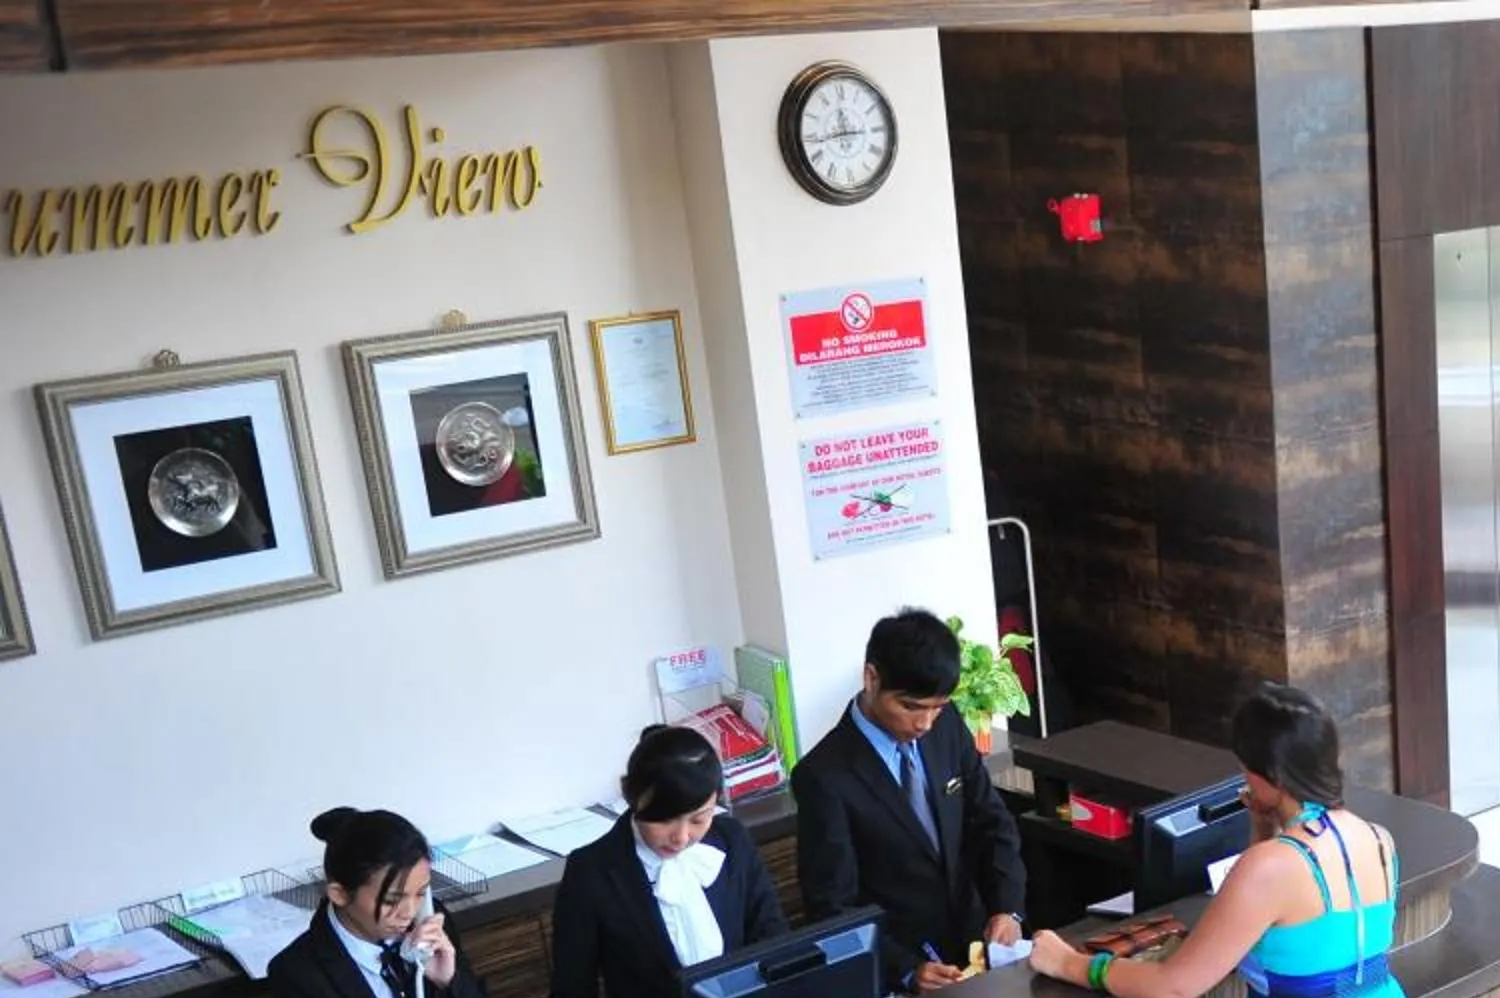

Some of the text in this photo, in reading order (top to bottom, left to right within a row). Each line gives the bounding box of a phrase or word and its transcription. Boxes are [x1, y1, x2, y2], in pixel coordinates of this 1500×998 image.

[3, 104, 543, 257] ummer View
[800, 338, 921, 362] DILARANG MEROKOK
[821, 329, 898, 349] NO SMOKING
[815, 427, 929, 457] DO NOT LEAVE YOUR
[807, 454, 863, 473] BAGGAGE
[866, 441, 939, 463] UNATTENDED
[669, 650, 707, 668] FREE
